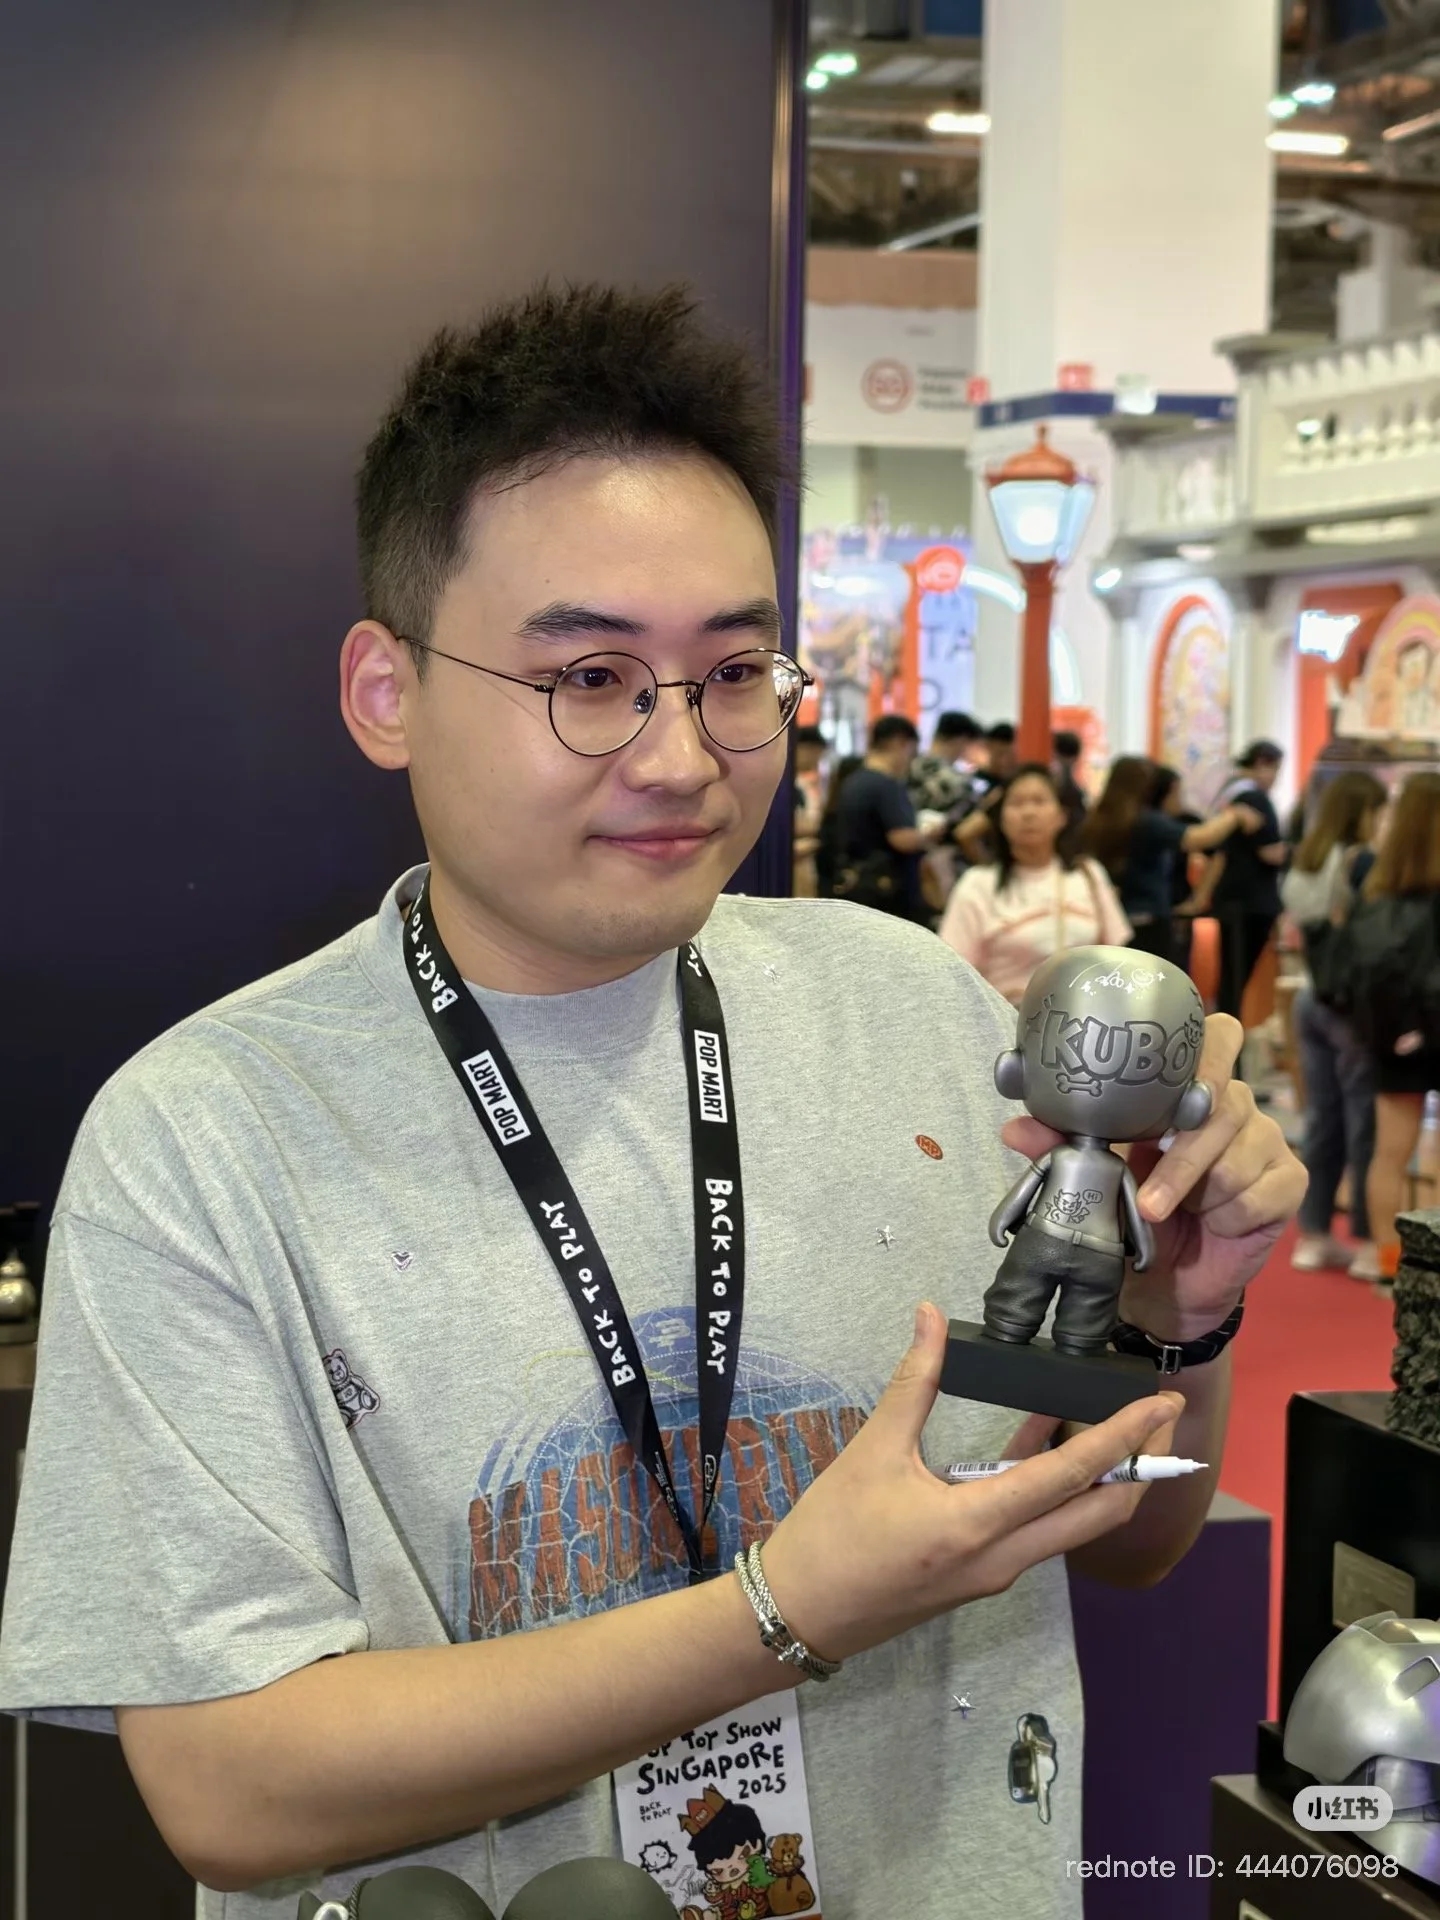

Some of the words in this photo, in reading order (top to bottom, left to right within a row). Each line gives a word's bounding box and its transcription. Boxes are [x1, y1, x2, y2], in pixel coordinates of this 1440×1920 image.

[411, 912, 423, 944] TO
[415, 944, 458, 1013] BACK
[698, 1035, 717, 1068] POP
[1041, 1010, 1197, 1087] KUBO
[468, 1059, 507, 1106] MART
[701, 1071, 723, 1118] MART
[493, 1107, 525, 1140] POP
[539, 1201, 585, 1260] PLAY
[705, 1178, 734, 1251] BACK
[578, 1267, 600, 1303] TO
[711, 1262, 731, 1296] TO
[593, 1309, 636, 1387] BACK
[707, 1310, 731, 1375] PLAY
[726, 1717, 782, 1745] SHOW
[637, 1742, 785, 1795] SINGAPORE
[738, 1772, 786, 1799] 2025
